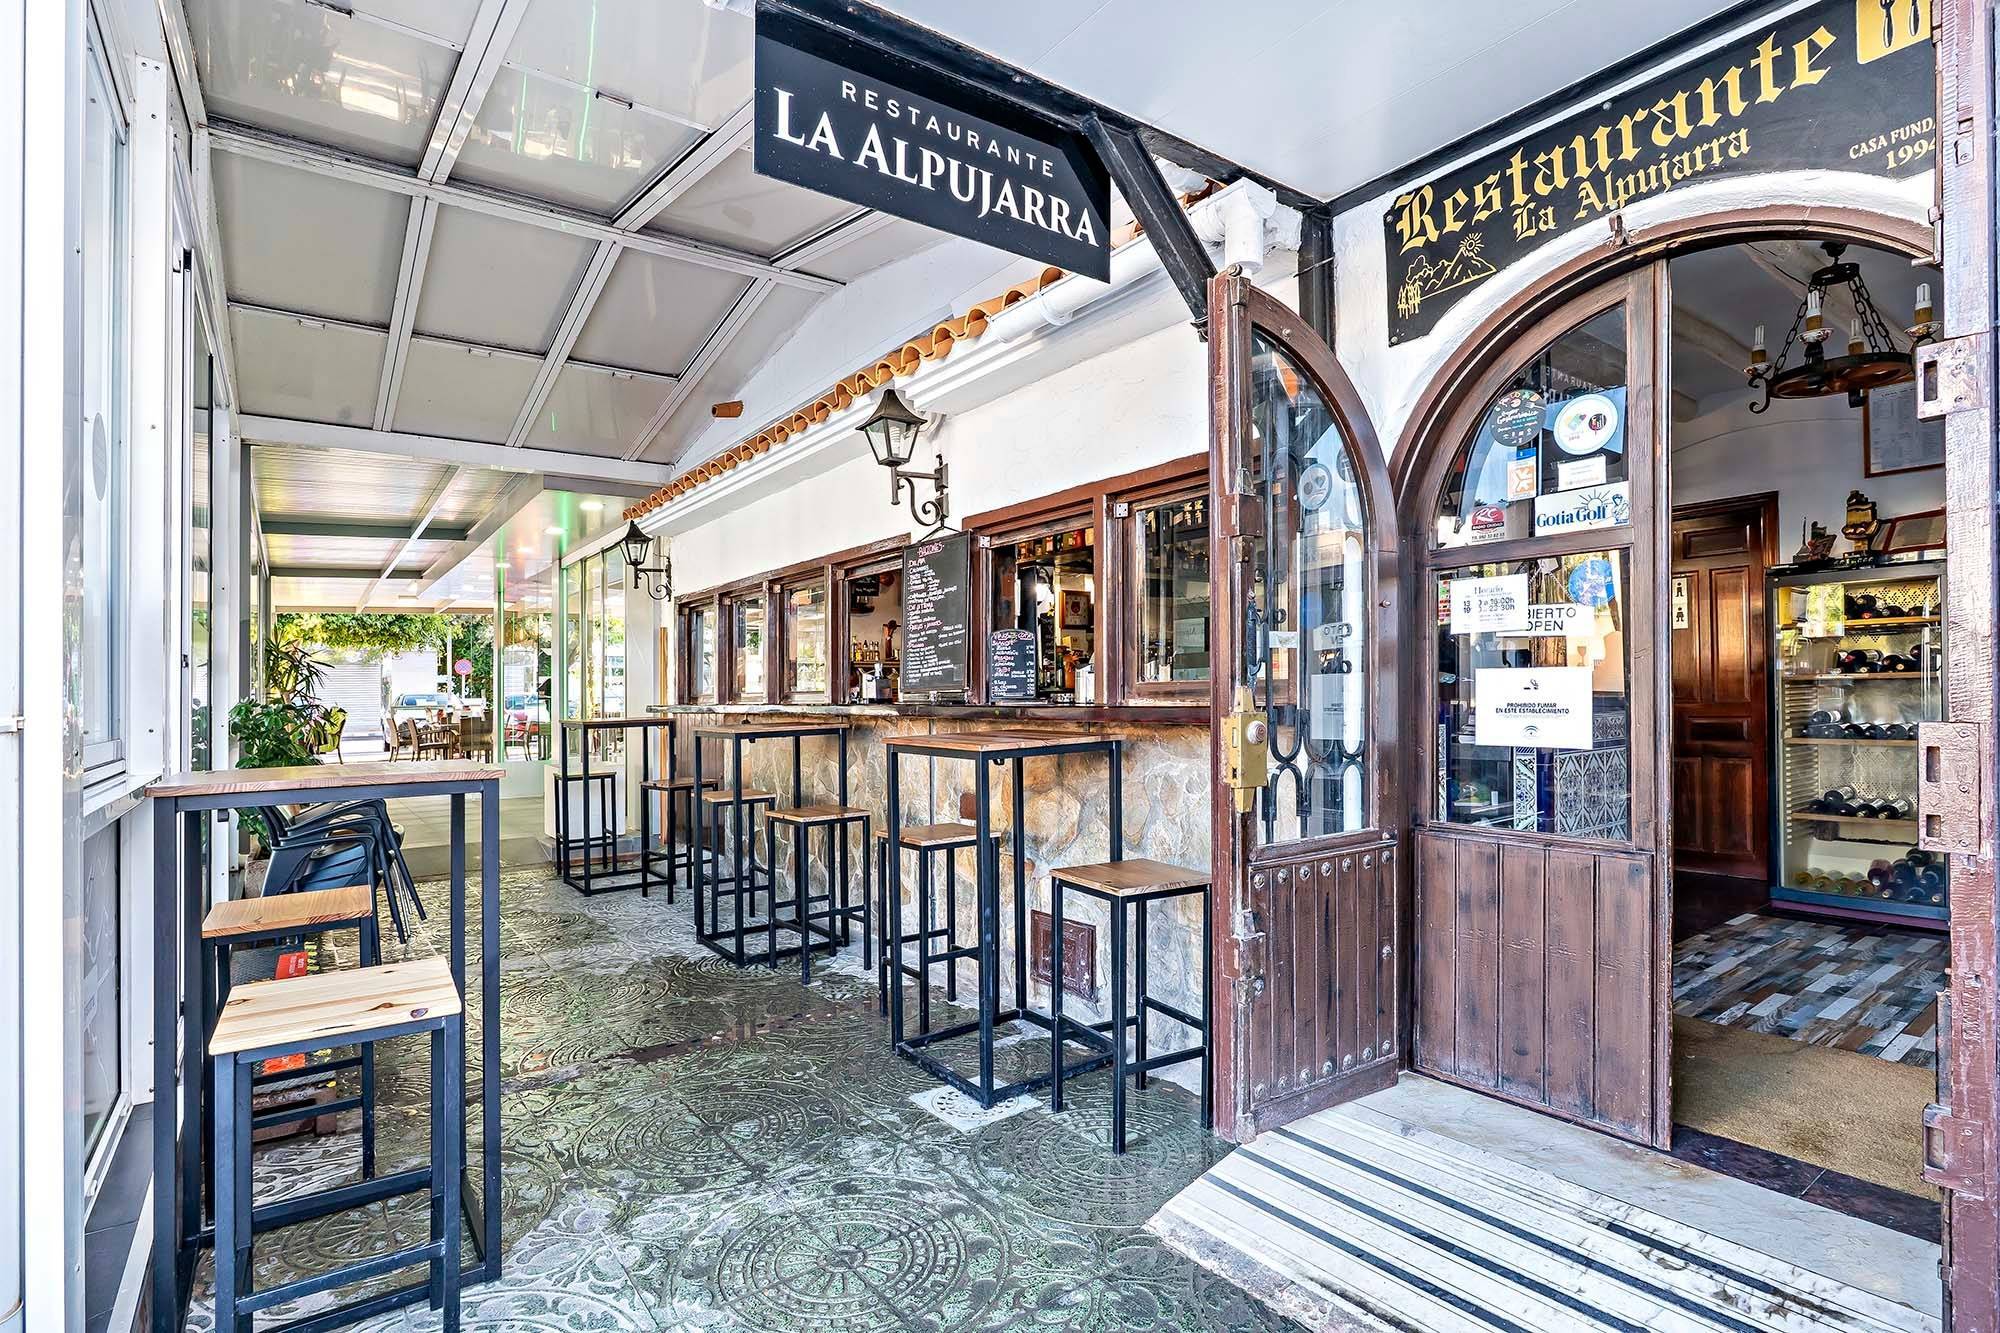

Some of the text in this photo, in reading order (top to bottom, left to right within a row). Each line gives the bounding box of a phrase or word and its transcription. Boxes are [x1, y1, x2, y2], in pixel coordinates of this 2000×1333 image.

[773, 87, 1099, 248] LA ALPUJARRA
[842, 80, 1054, 178] RESTAURANTE
[1395, 24, 1837, 256] Restaurante
[1849, 116, 1936, 159] CASA FUND
[1511, 128, 1751, 242] La Alpujarra
[1536, 505, 1607, 528] Gotia Golf
[1528, 607, 1577, 619] BIERTO
